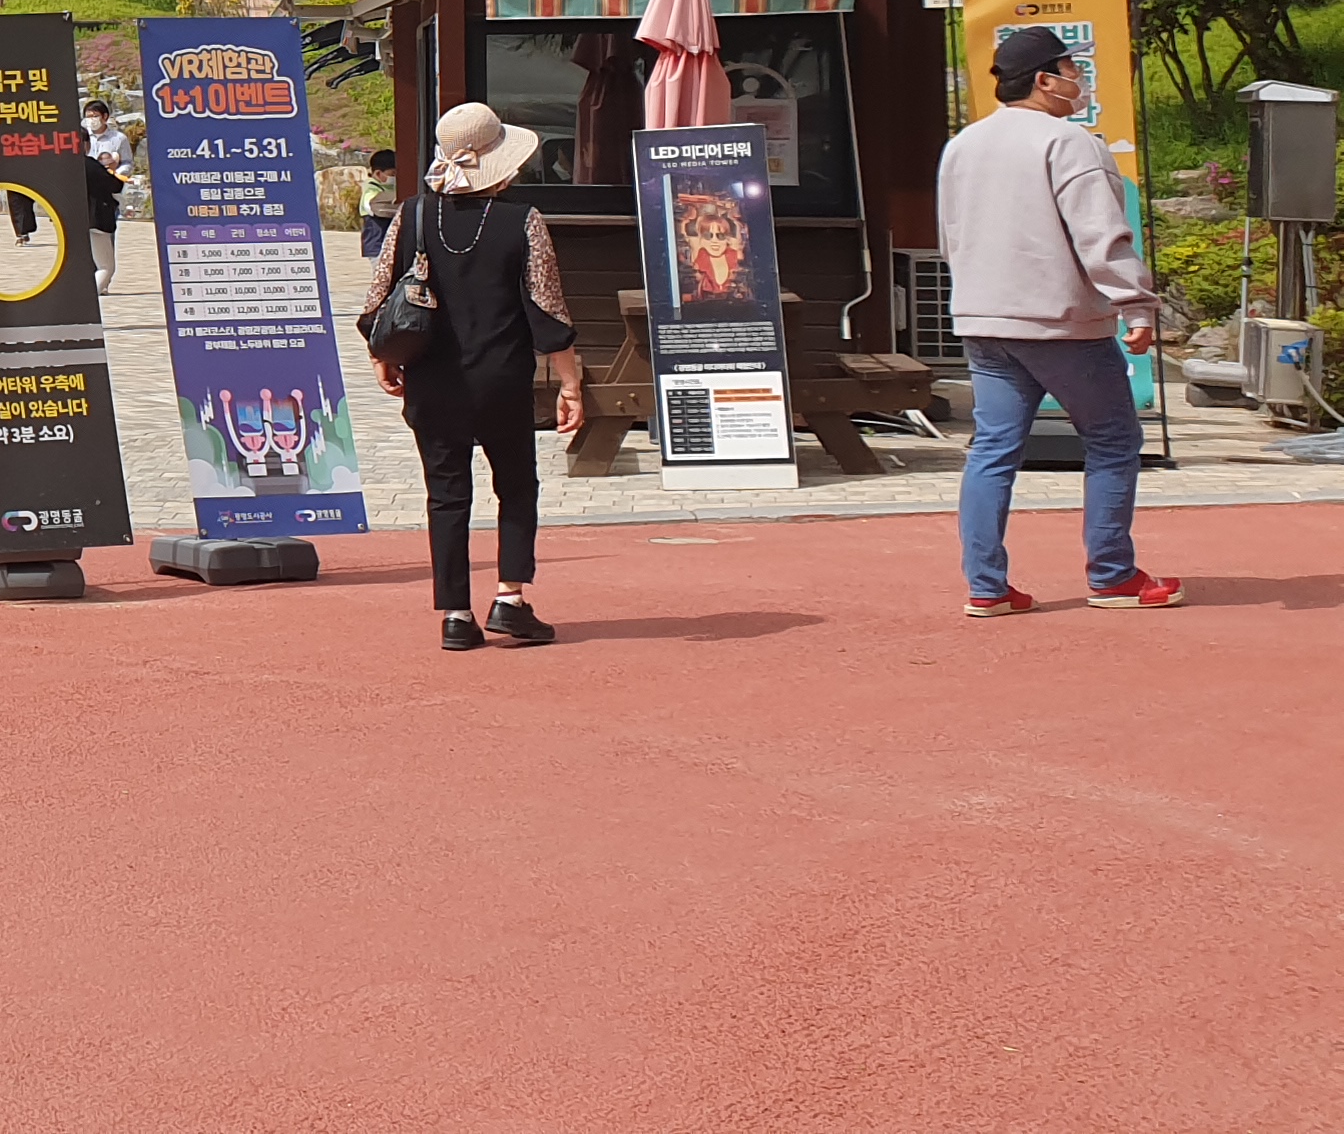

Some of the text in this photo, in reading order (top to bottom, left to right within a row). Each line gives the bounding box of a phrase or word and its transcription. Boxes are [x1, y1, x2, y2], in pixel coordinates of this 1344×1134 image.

[163, 49, 274, 80] VR체험관
[28, 68, 49, 92] 및
[158, 82, 293, 114] 1+1 이벤트
[0, 131, 80, 157] 없습니다
[650, 141, 752, 160] LED 미디어 타워
[172, 171, 221, 184] VR체험관
[223, 170, 255, 183] 이용권
[280, 170, 291, 182] 시
[240, 204, 261, 216] 추가
[40, 373, 85, 393] 우측에
[28, 397, 88, 418] 있습니다
[11, 425, 36, 443] 3분
[38, 424, 74, 444] 소요)
[38, 508, 83, 525] 광명동굴
